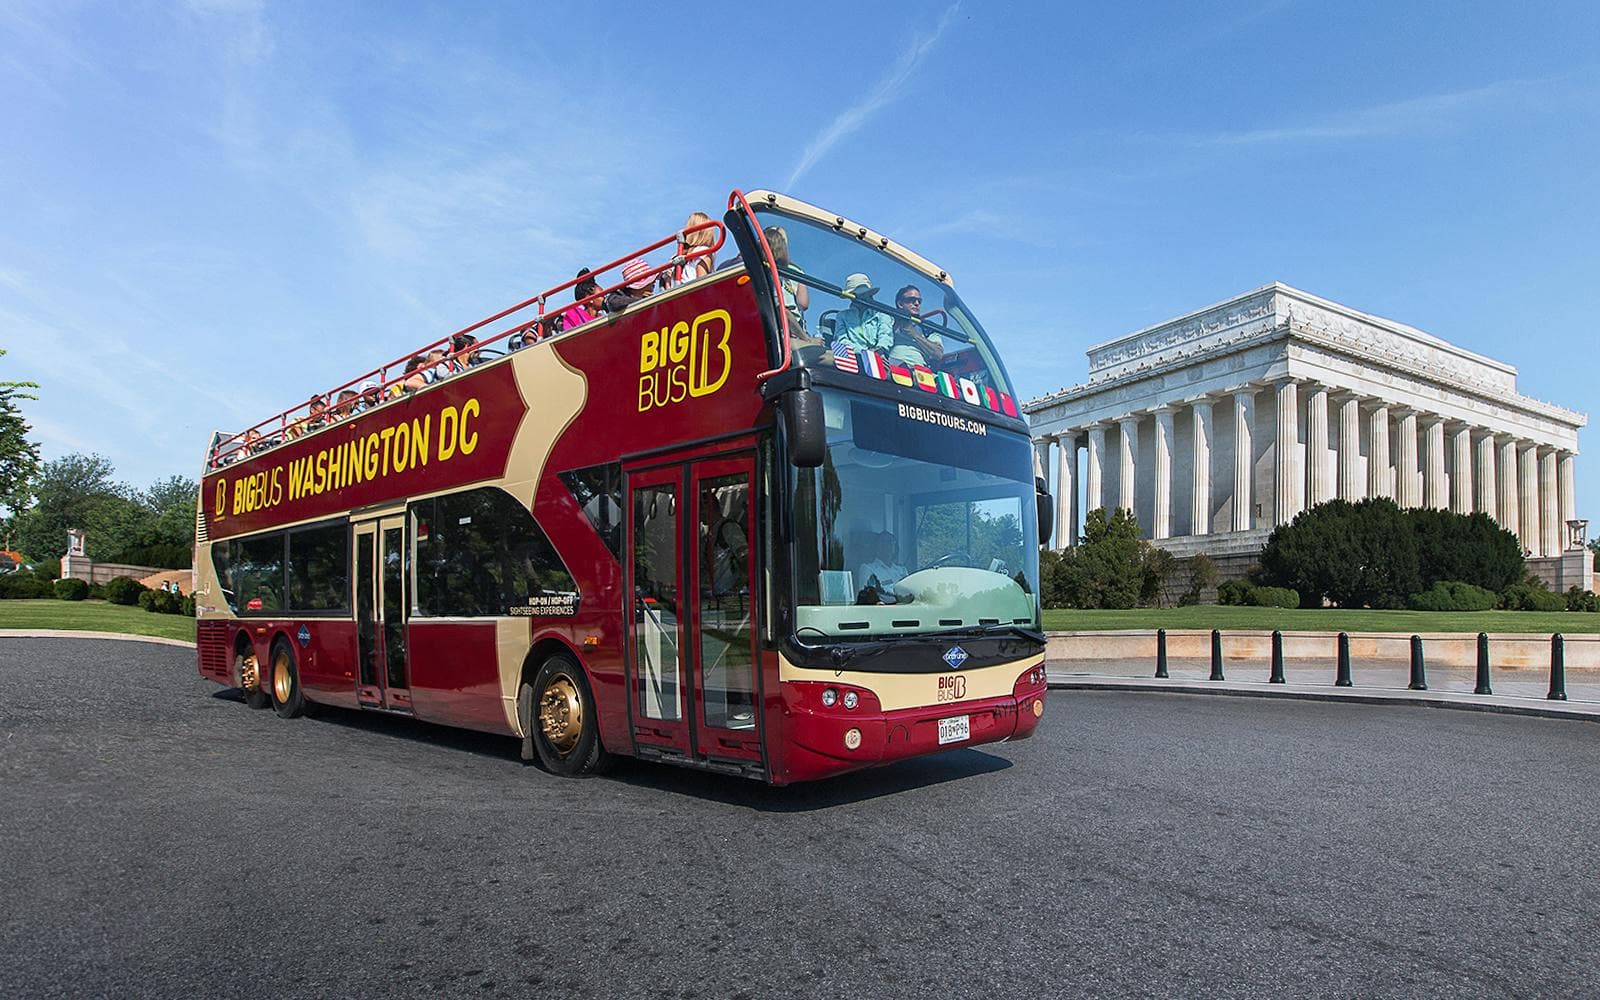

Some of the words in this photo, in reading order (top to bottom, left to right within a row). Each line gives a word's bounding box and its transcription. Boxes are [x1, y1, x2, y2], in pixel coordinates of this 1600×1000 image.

[641, 321, 690, 373] BIG
[639, 365, 687, 412] BUS
[898, 403, 987, 436] BIGBUSTOURS.COM
[288, 414, 430, 501] WASHINGTON
[438, 398, 480, 462] DC
[540, 606, 574, 615] EXPERIENCES
[937, 689, 954, 702] BUS
[938, 676, 954, 689] BIG
